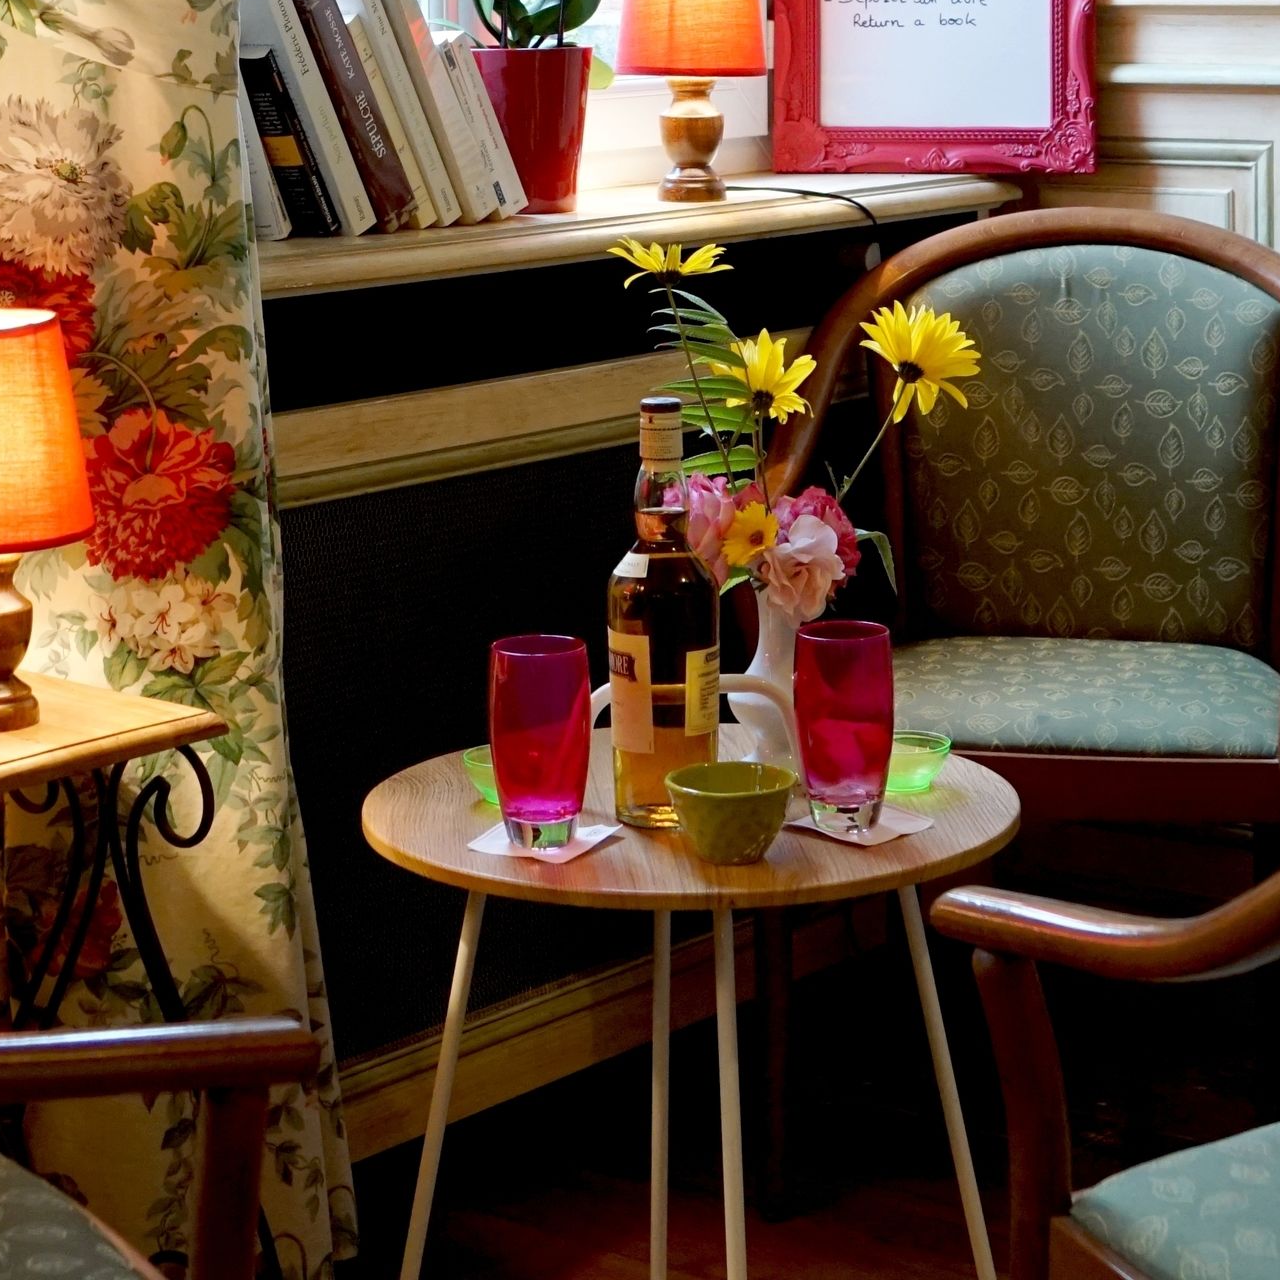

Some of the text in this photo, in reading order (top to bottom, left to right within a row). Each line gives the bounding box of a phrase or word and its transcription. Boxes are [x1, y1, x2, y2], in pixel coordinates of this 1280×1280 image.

[324, 7, 356, 80] KATE MOSSE
[852, 12, 977, 28] Return a book
[290, 33, 309, 76] Frédéric
[355, 90, 387, 159] SÉPULCRE
